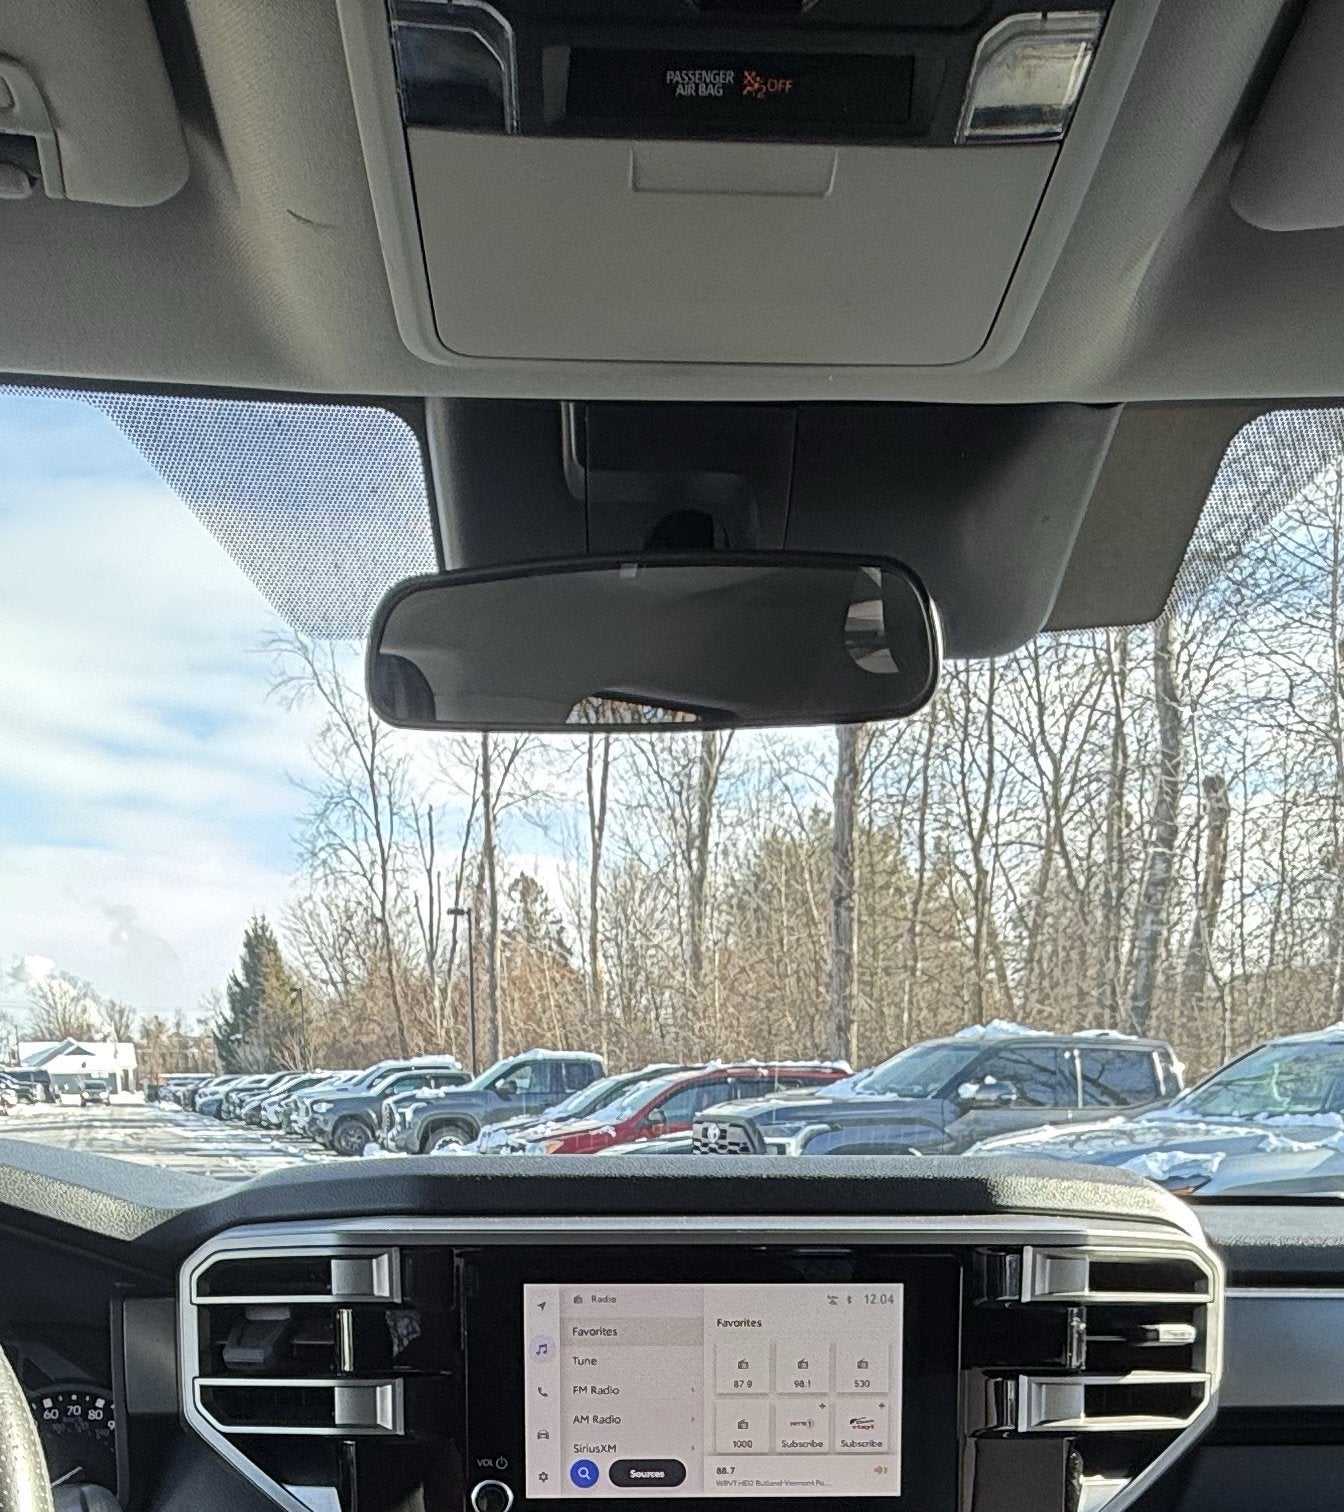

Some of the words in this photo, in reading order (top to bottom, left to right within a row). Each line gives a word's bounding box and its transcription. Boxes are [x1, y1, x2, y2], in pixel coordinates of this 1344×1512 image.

[666, 70, 734, 84] PASSENGER
[675, 83, 696, 97] AIR
[698, 83, 724, 97] BAG
[767, 79, 794, 92] OFF
[716, 1318, 763, 1328] Favorites
[572, 1326, 618, 1337] Favorites
[572, 1356, 598, 1366] Tune
[853, 1379, 871, 1389] 530
[573, 1385, 588, 1395] FM
[590, 1385, 620, 1395] Radio
[43, 1409, 59, 1420] 60
[66, 1404, 82, 1416] 70
[87, 1409, 104, 1420] 80
[572, 1415, 590, 1425] AM
[592, 1415, 622, 1425] Radio
[107, 1420, 116, 1431] 9
[573, 1444, 617, 1454] SiriusXM
[732, 1440, 753, 1449] 1000
[781, 1440, 824, 1449] Subscribe
[840, 1440, 883, 1449] Subscribe
[477, 1458, 494, 1467] VOL
[629, 1469, 666, 1479] Sources
[716, 1466, 736, 1475] 88.7
